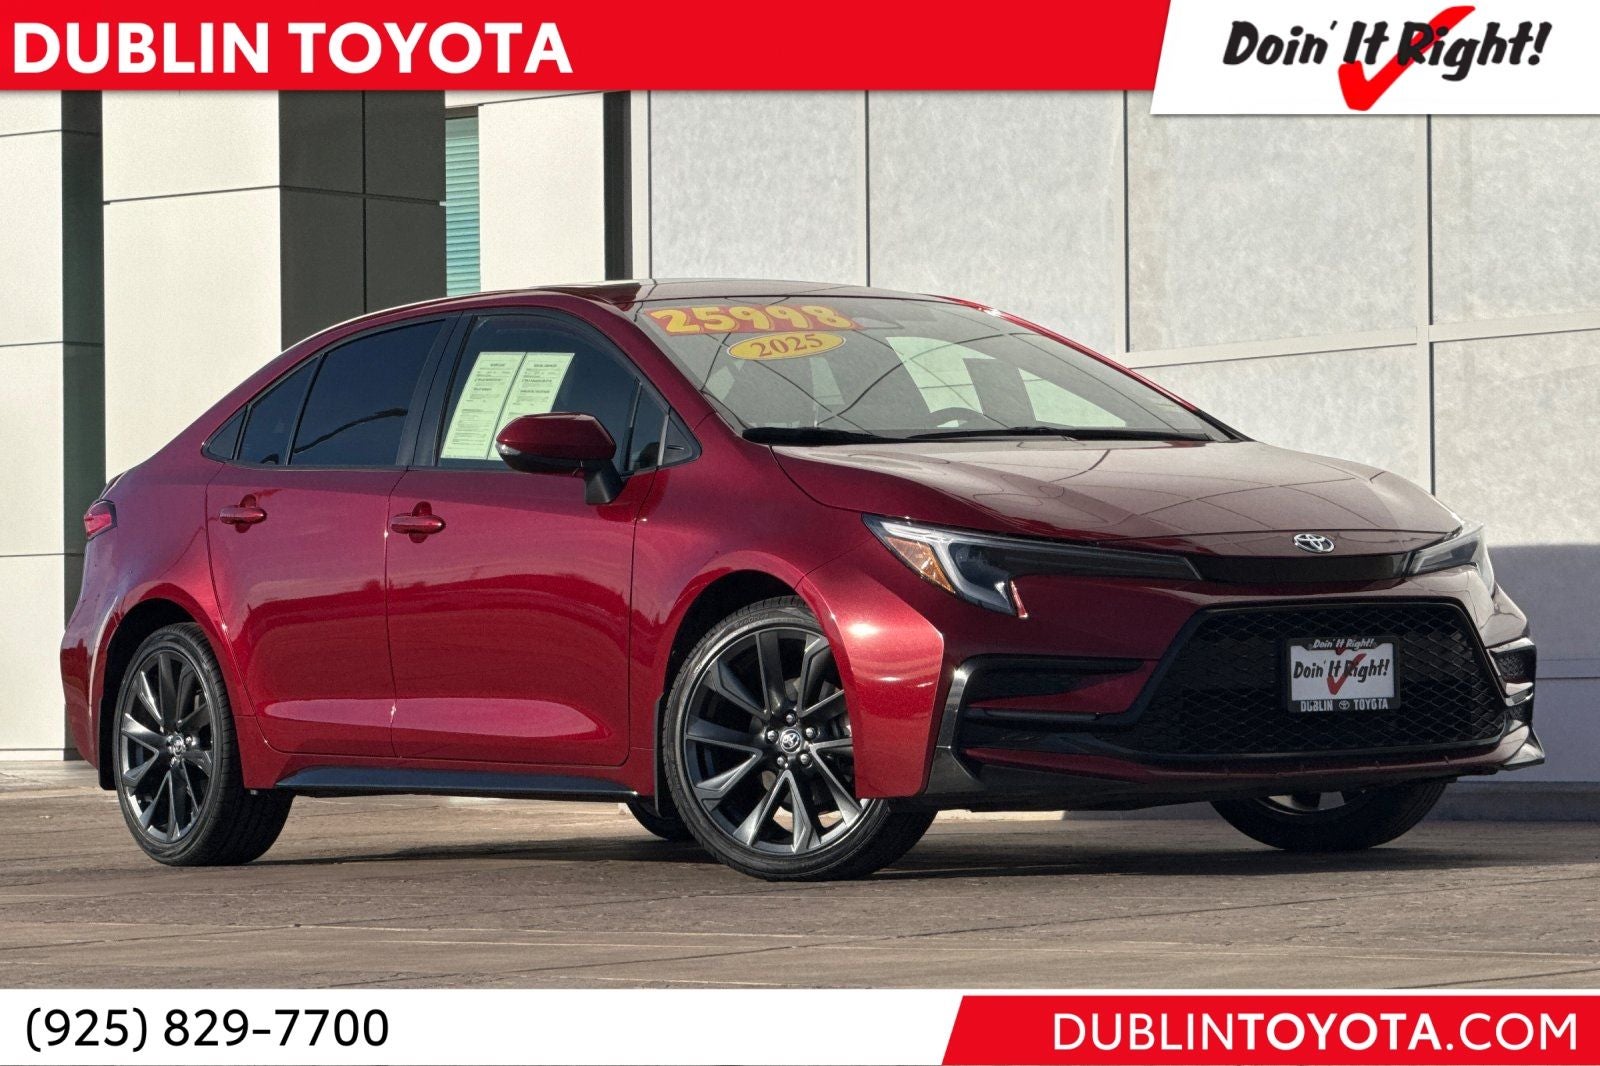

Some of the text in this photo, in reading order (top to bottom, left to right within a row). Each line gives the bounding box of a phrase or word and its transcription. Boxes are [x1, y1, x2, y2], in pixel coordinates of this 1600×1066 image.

[650, 305, 854, 333] 25998
[750, 333, 824, 357] 2025
[1313, 638, 1376, 651] Doin' It Right!
[1293, 659, 1391, 683] Doin' It Right!
[1301, 698, 1389, 712] DUBLIN TOYOTA
